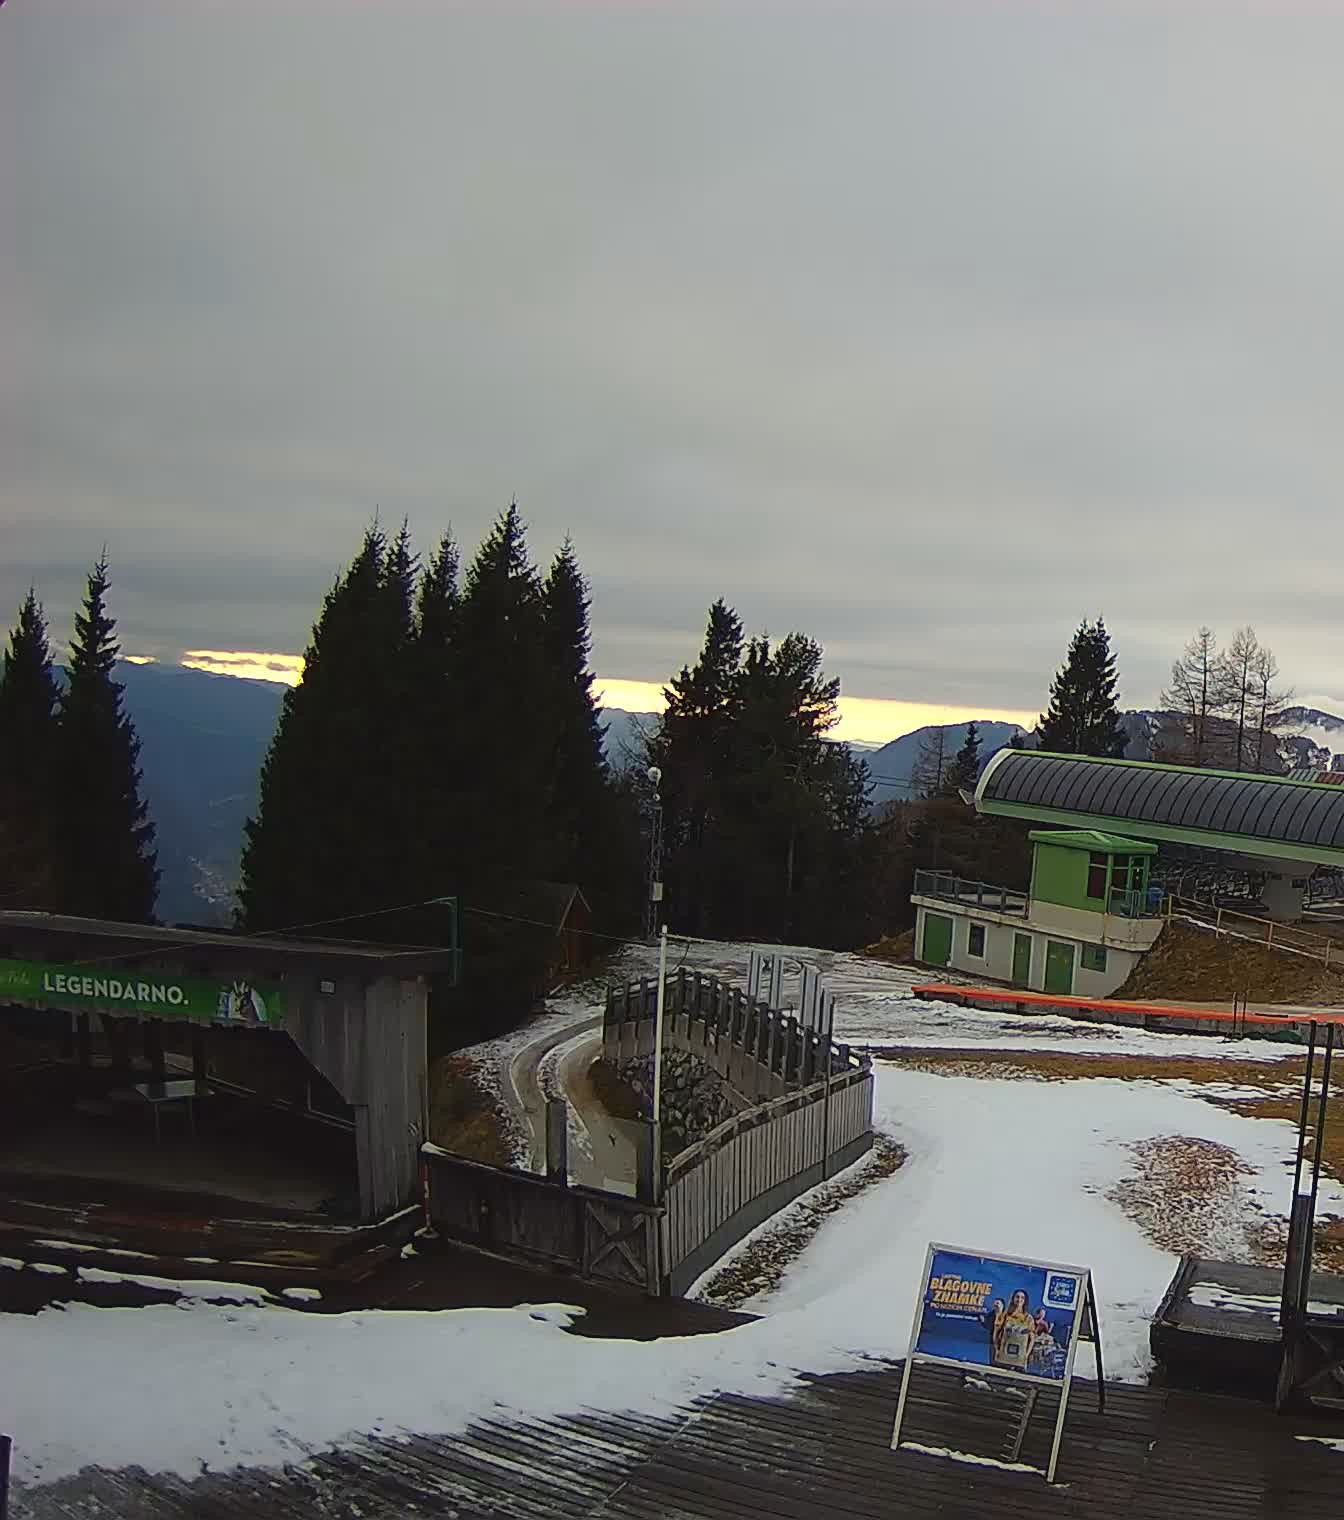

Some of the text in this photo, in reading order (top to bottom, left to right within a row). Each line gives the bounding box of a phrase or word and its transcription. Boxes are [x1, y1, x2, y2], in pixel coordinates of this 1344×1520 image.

[44, 972, 189, 1005] LEGENDARNO.
[930, 1277, 993, 1295] BLAGOVNE
[932, 1290, 985, 1306] ZNAMKE
